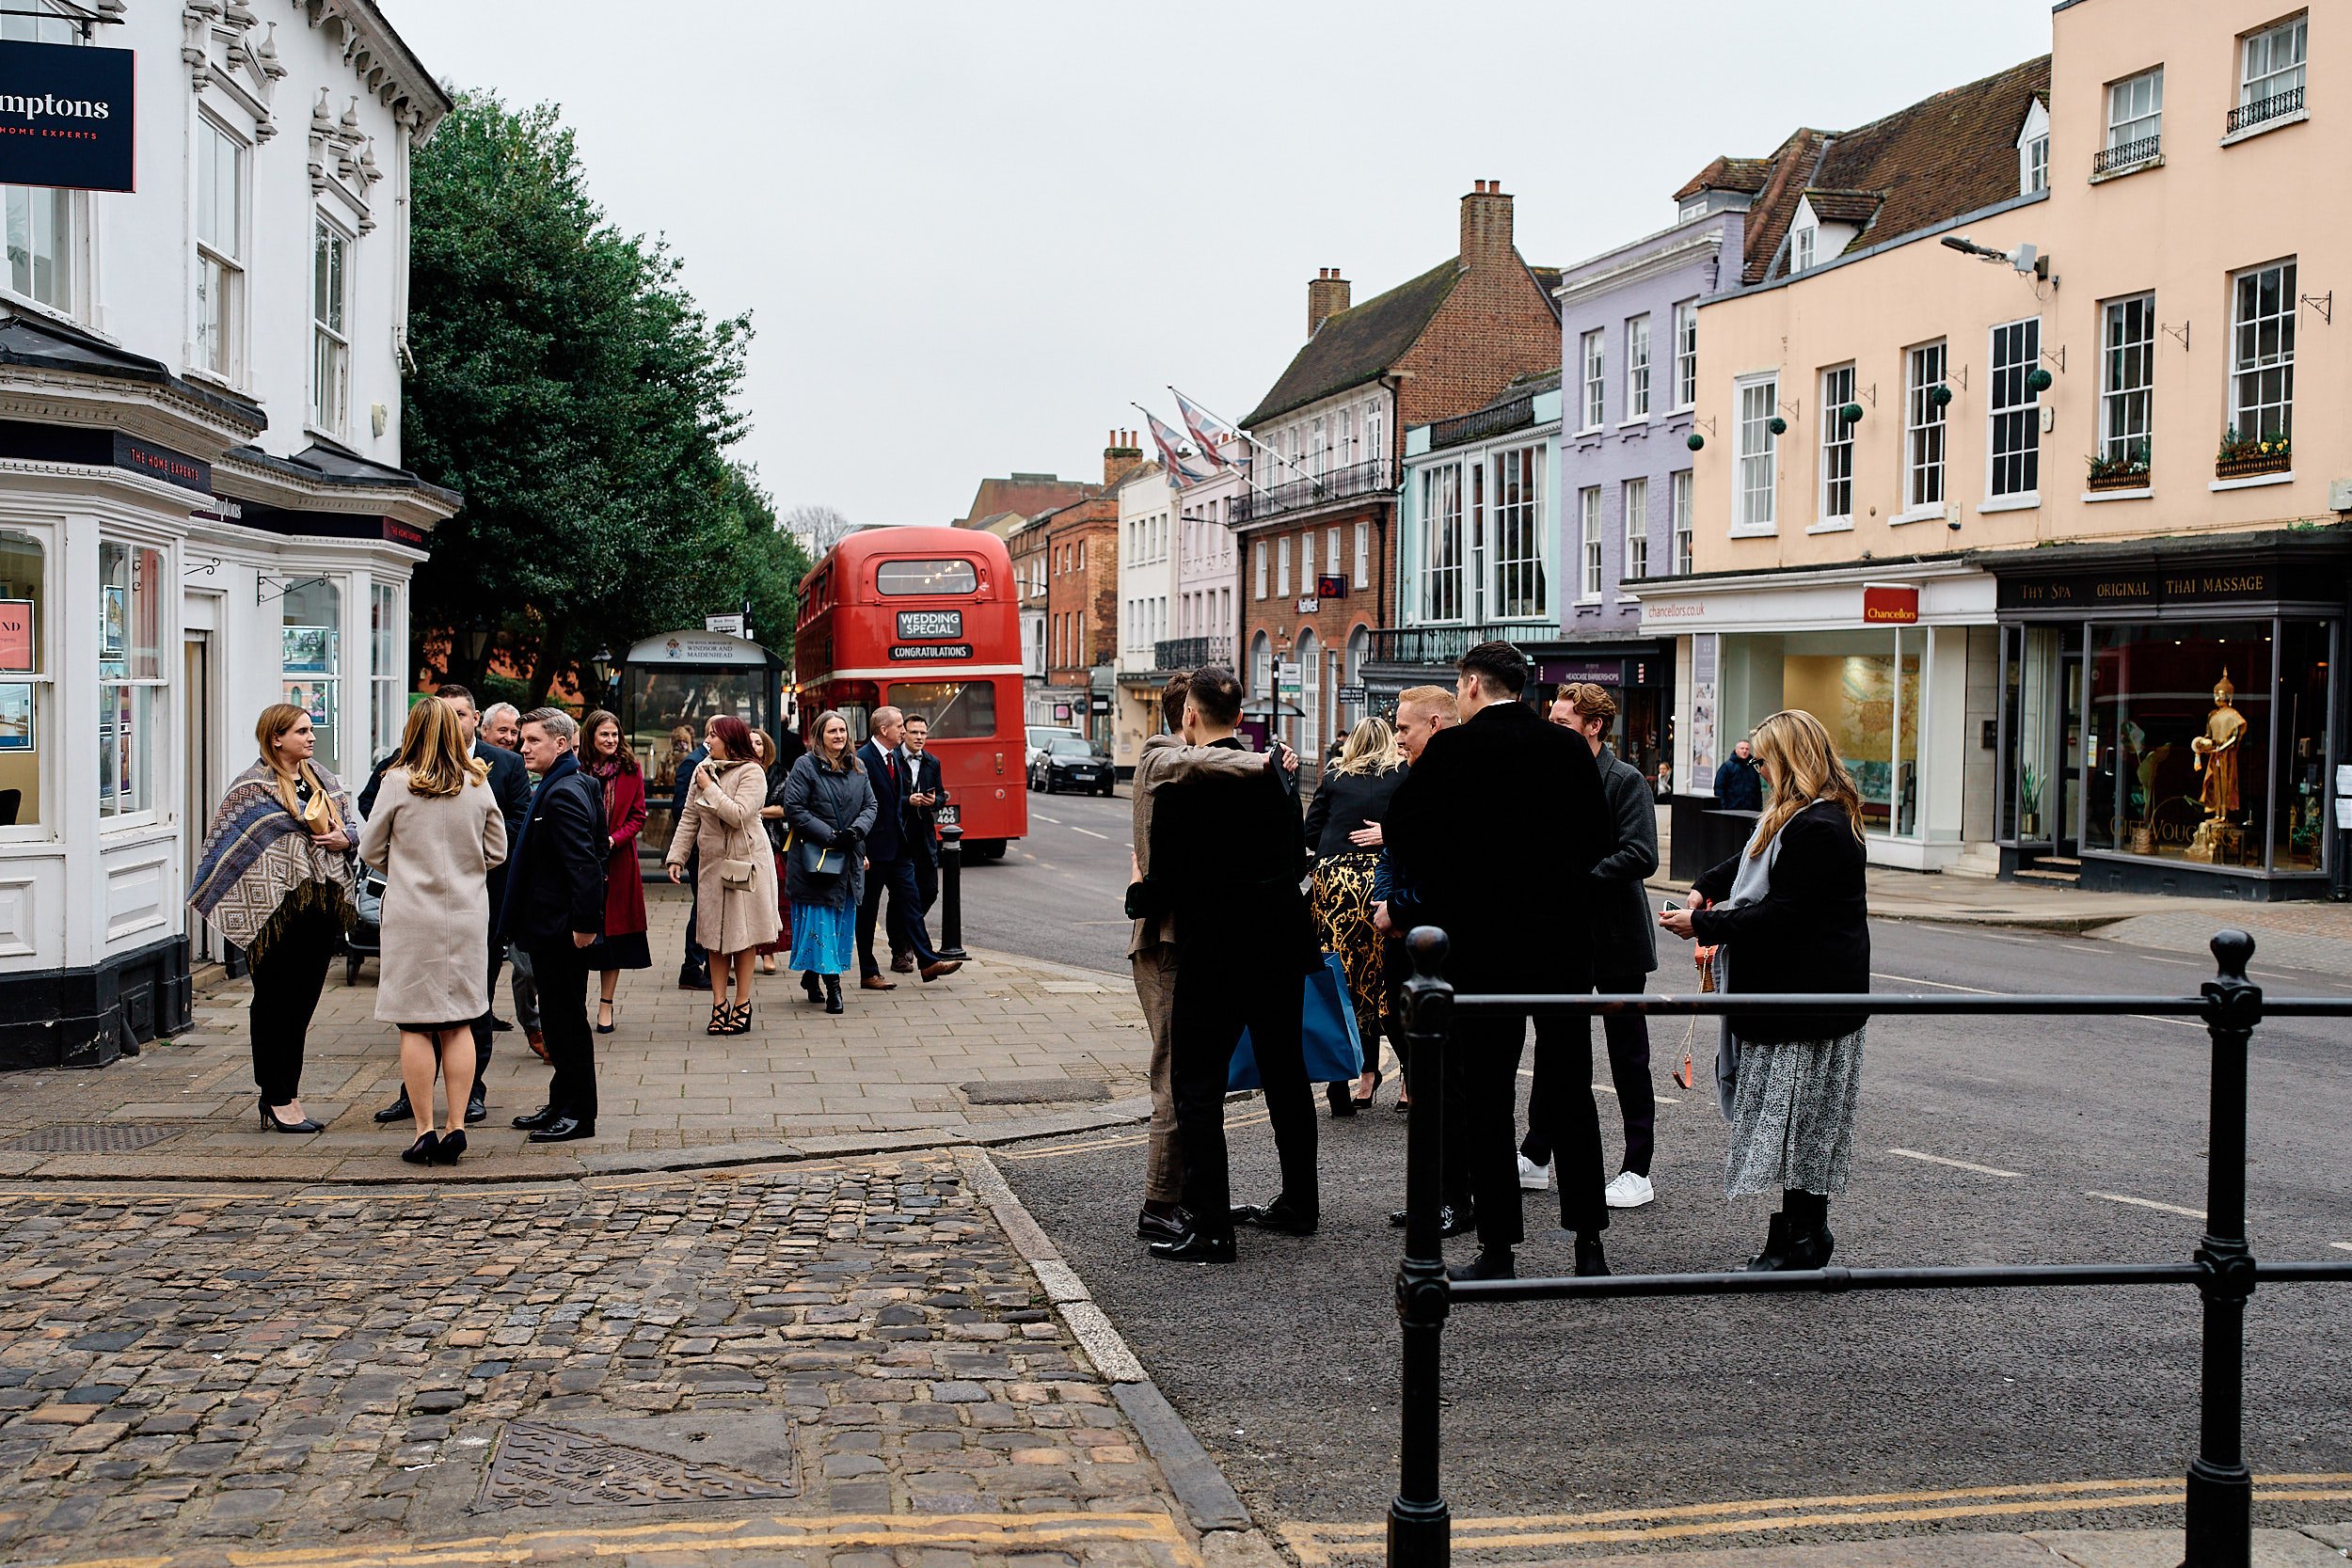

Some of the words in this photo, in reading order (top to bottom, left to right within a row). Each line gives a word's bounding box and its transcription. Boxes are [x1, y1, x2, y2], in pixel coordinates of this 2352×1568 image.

[0, 126, 35, 135] HOME
[42, 129, 97, 140] EXPERTS
[131, 449, 145, 464] THE
[148, 454, 167, 470] HOME
[170, 462, 199, 482] EXPERTS
[203, 498, 242, 522] mptons
[2097, 581, 2150, 597] ORIGINAL
[2166, 578, 2196, 594] THAI
[2203, 576, 2264, 593] MASSAGE
[1648, 601, 1706, 618] chancellors.co.uk
[1867, 607, 1916, 620] Chancellors
[900, 613, 960, 625] WEDDING
[906, 624, 954, 634] SPECIAL
[895, 646, 966, 657] CONGRATULATIONS
[937, 815, 956, 824] 466
